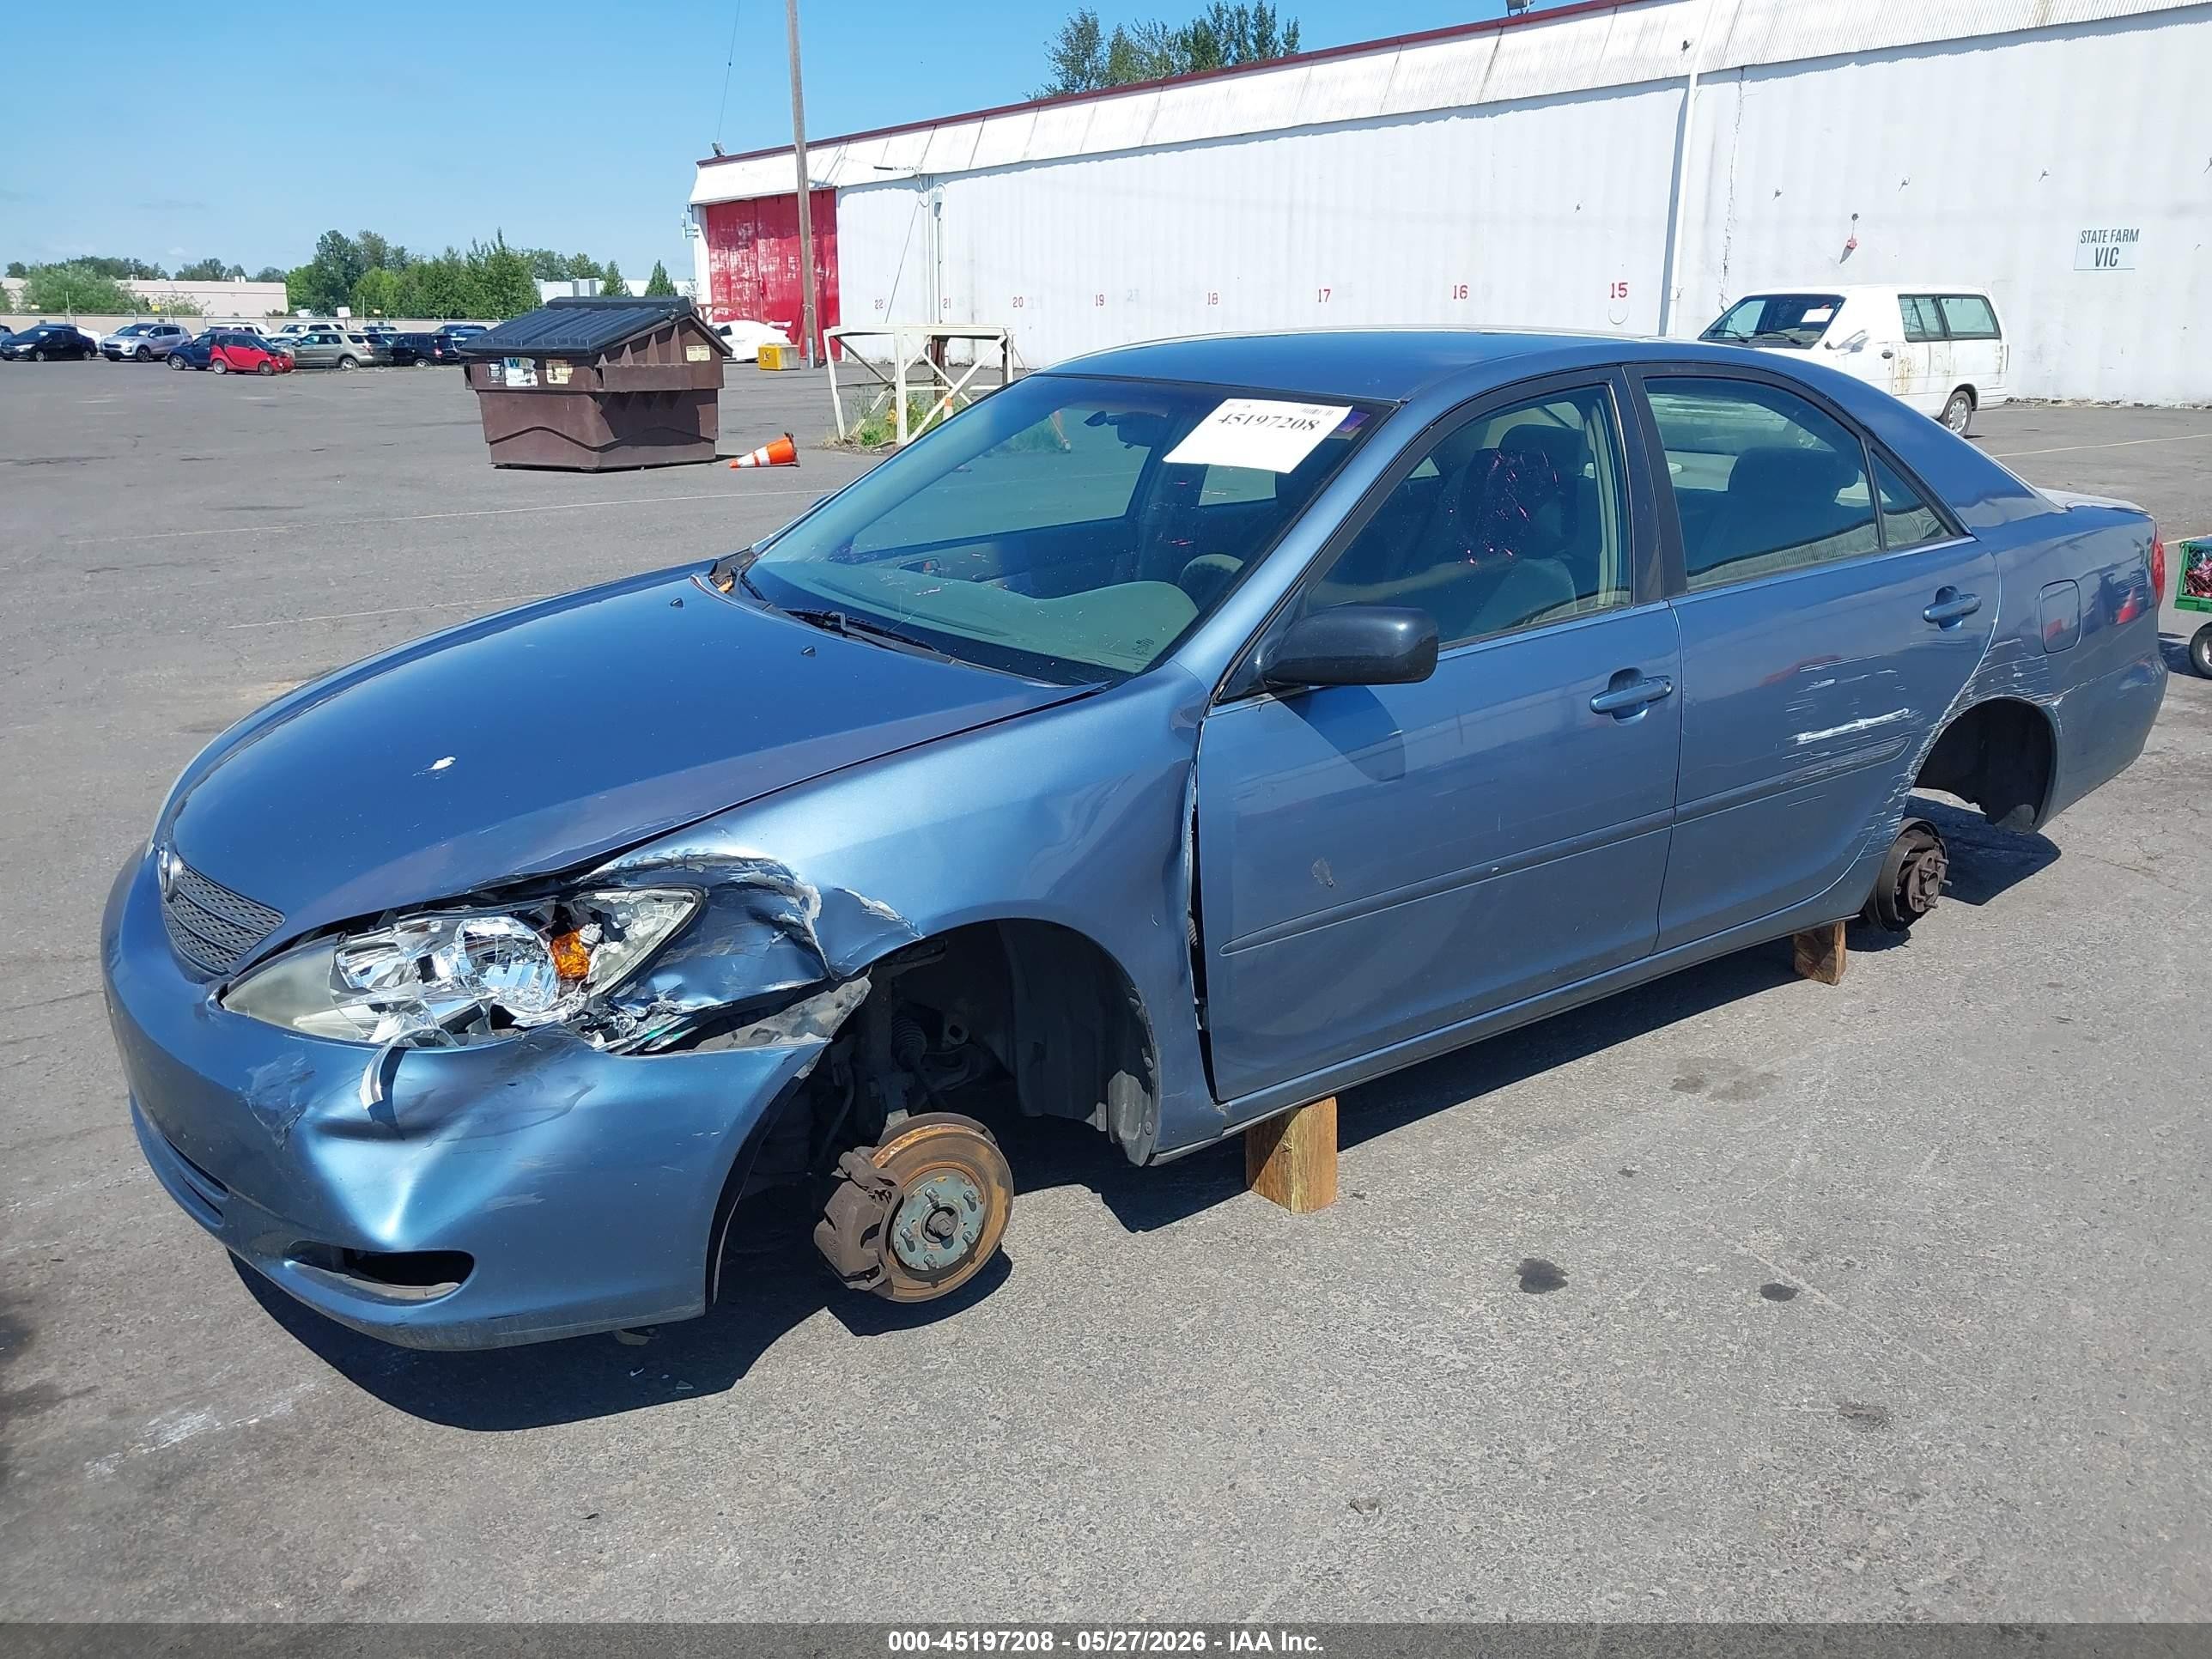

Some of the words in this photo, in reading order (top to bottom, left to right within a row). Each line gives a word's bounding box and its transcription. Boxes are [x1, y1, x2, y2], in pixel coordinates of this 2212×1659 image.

[2080, 229, 2108, 244] STATE
[2110, 228, 2140, 243] FARM
[2095, 246, 2119, 267] VIC
[1207, 292, 1218, 306] 18
[1317, 289, 1331, 303] 17
[1453, 284, 1468, 300] 16
[1610, 282, 1629, 300] 15
[1012, 296, 1024, 308] 20
[1095, 294, 1105, 307] 19
[1218, 412, 1320, 430] 45197208
